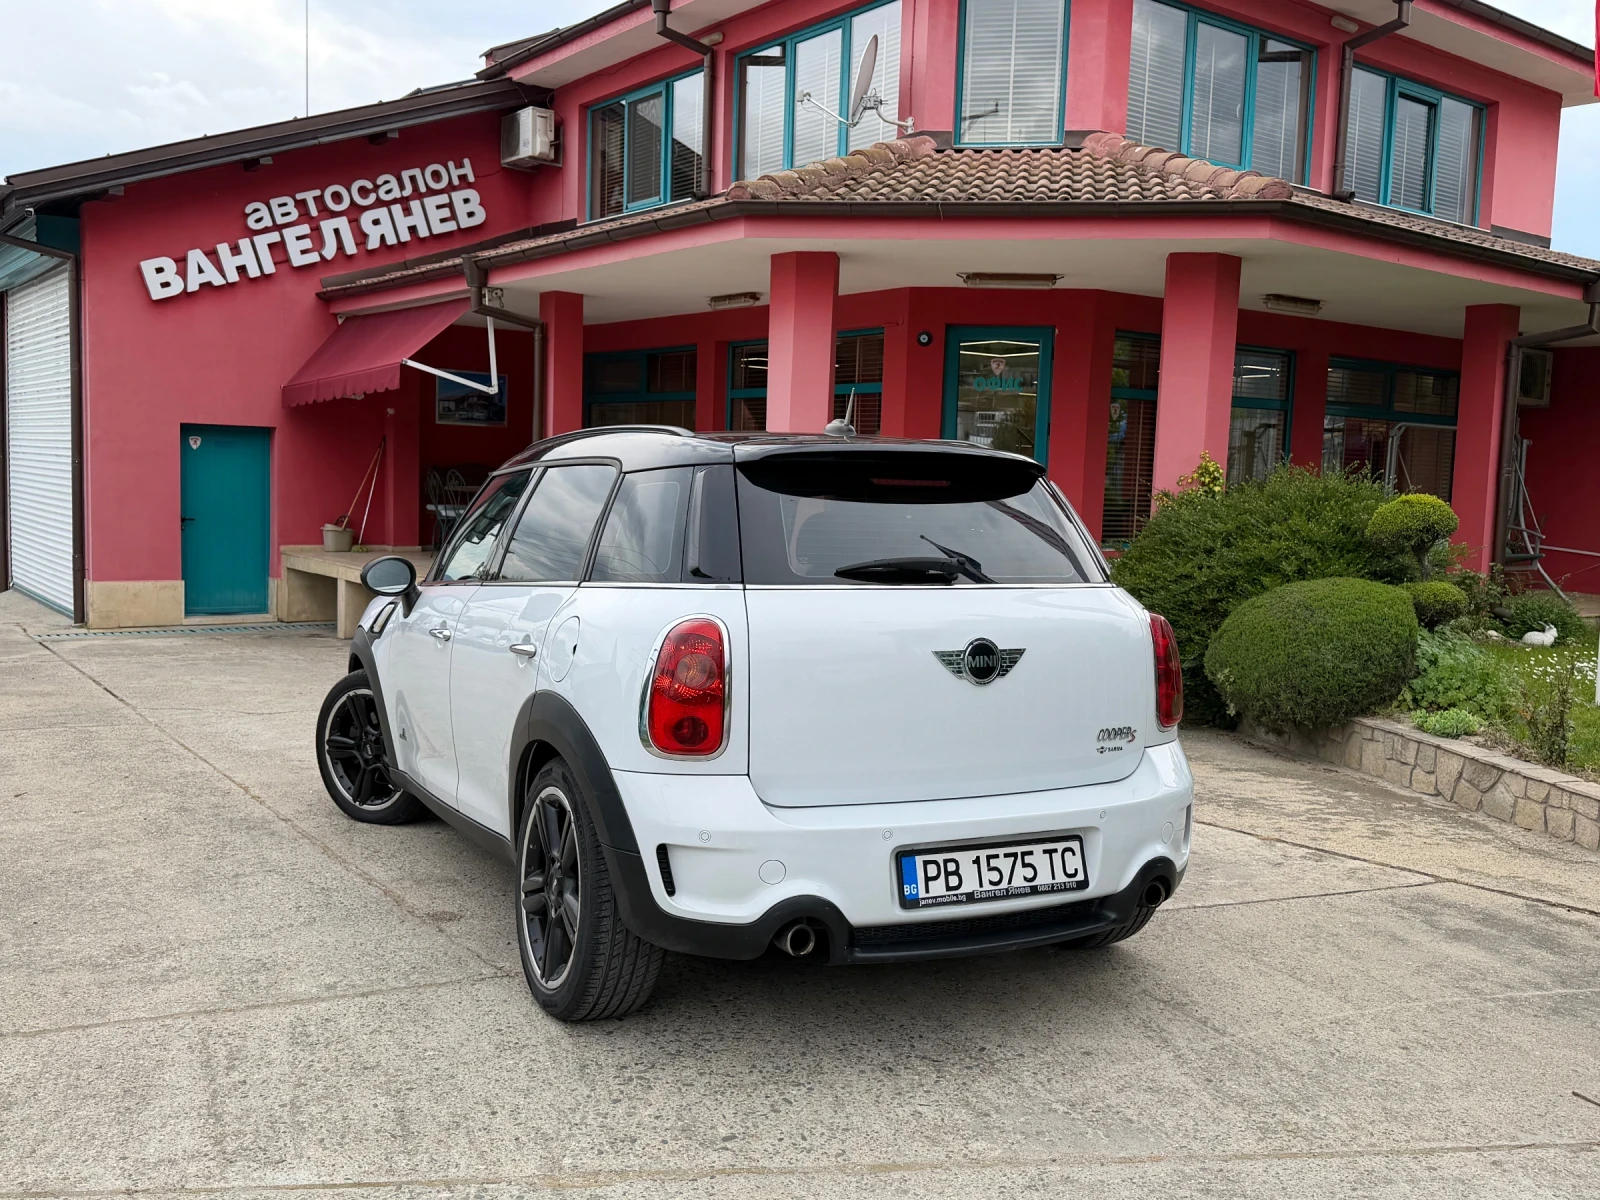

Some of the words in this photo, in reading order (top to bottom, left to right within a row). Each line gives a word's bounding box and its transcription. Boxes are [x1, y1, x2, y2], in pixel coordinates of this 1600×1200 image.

[244, 158, 476, 231] автосалон
[139, 216, 358, 301] ВАНГЕЛ
[359, 188, 487, 251] ЯНЕВ
[973, 376, 1024, 392] ОФИС
[967, 654, 997, 668] MINI
[972, 850, 1038, 889] 1575
[904, 883, 918, 896] BG
[973, 889, 1007, 899] Вангел
[1007, 886, 1031, 895] Янев
